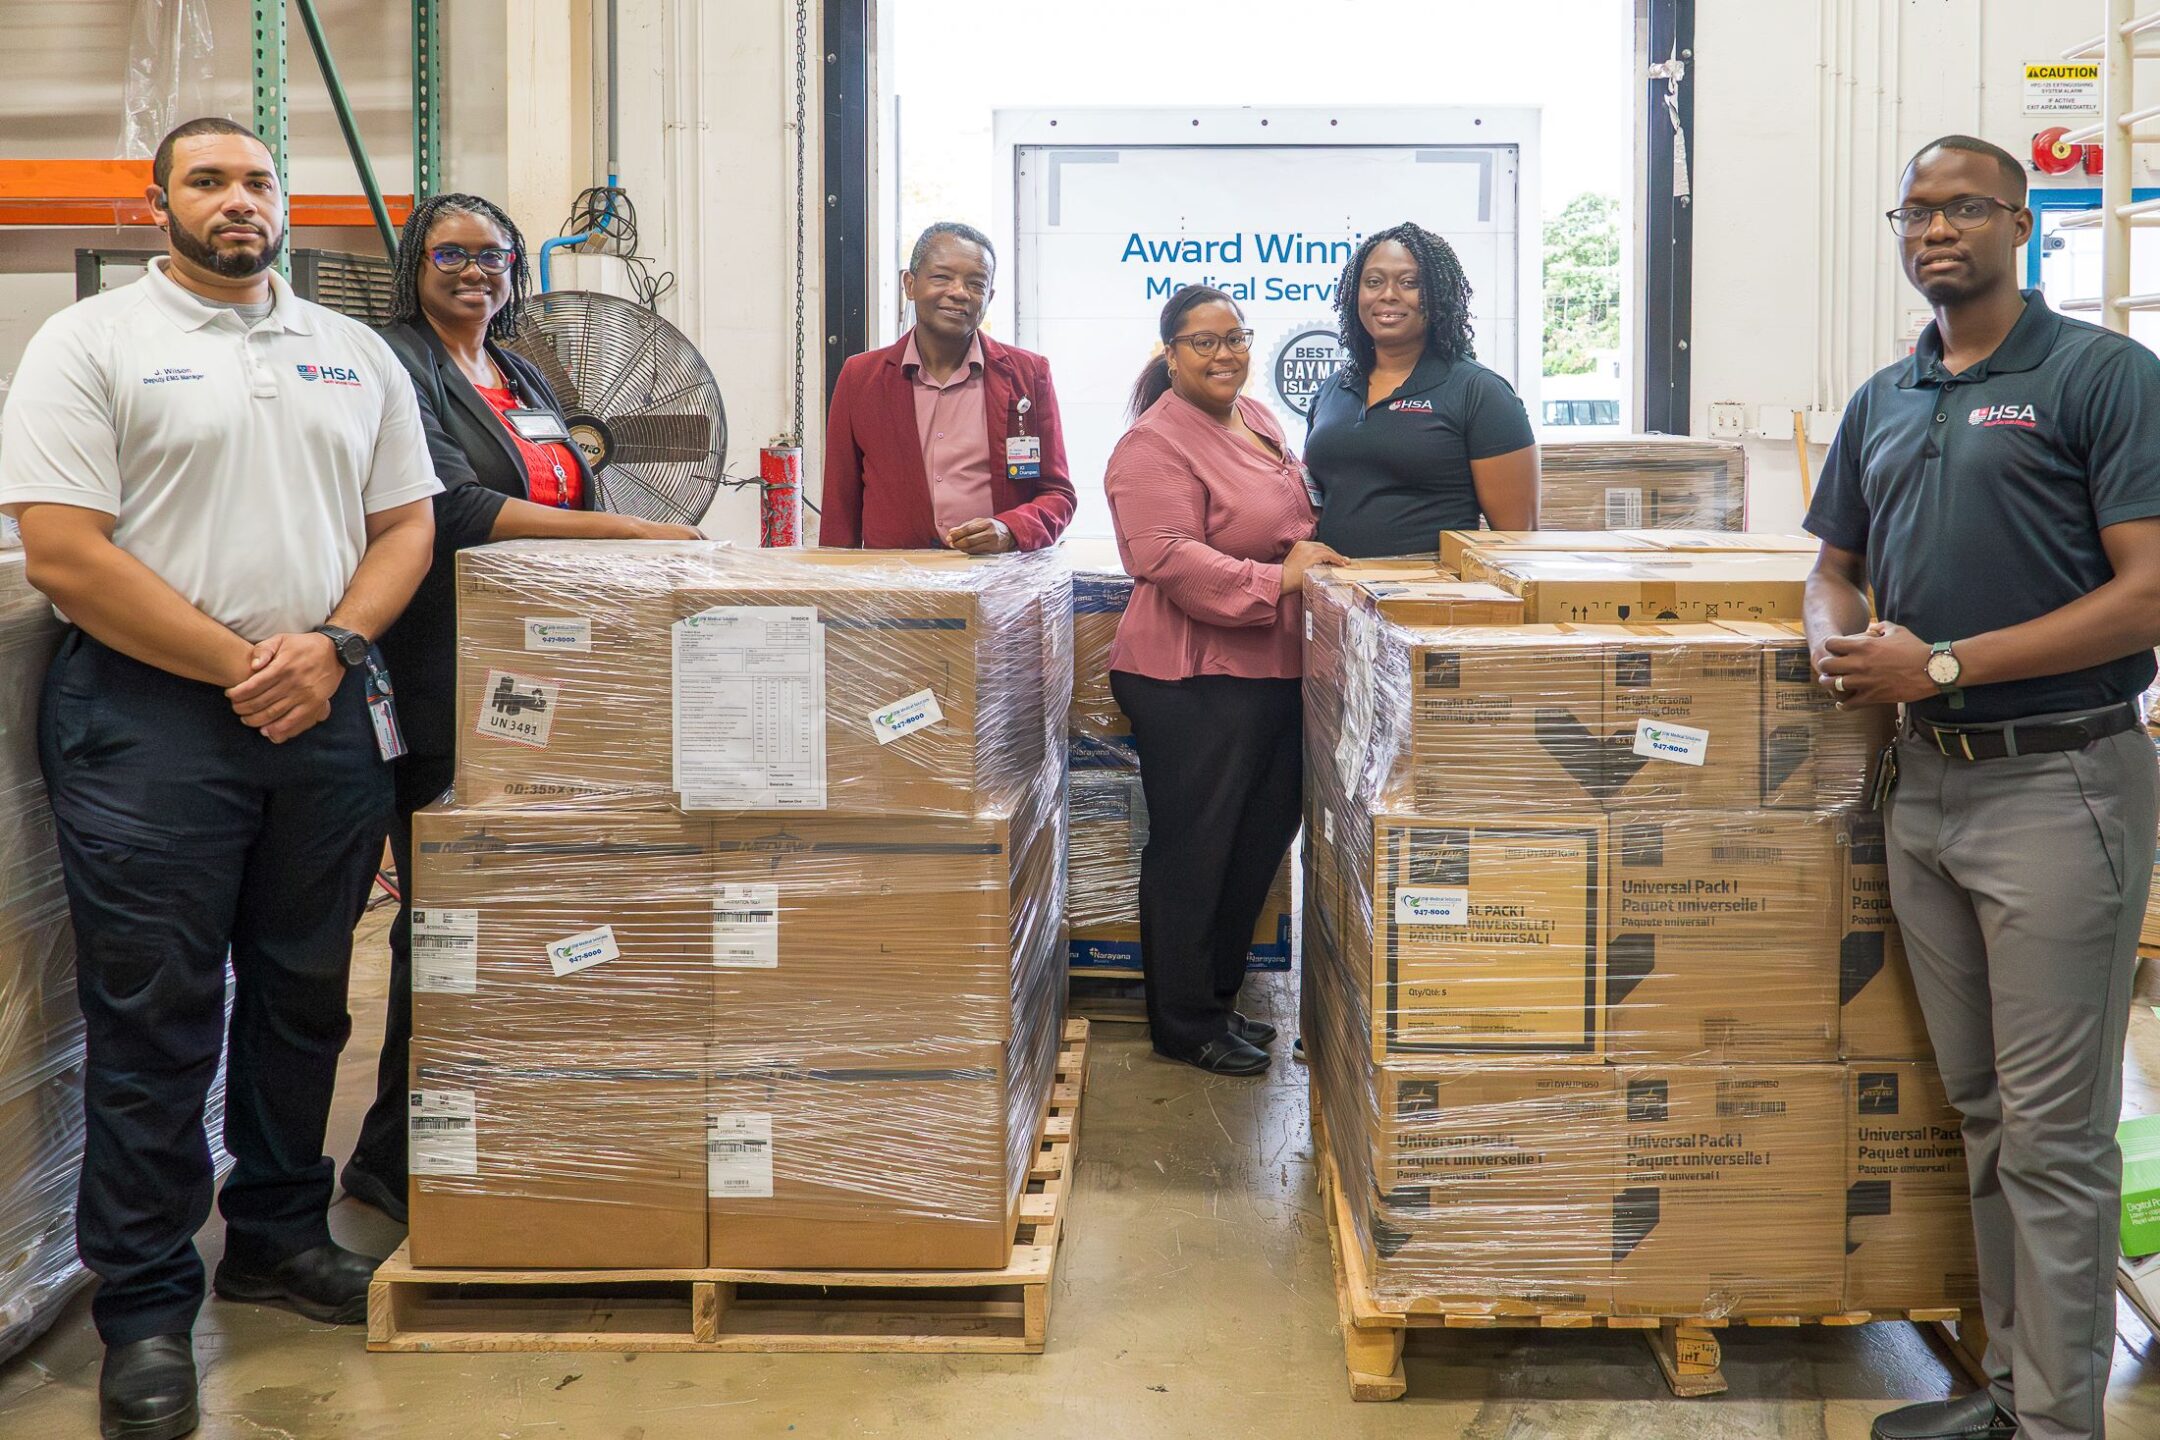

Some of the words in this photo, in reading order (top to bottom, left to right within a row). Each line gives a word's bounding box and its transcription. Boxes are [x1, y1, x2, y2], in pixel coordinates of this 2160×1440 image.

[2039, 67, 2098, 78] CAUTION
[1121, 233, 1242, 263] Award
[1254, 233, 1362, 264] Winni
[1265, 276, 1338, 301] Servi
[1296, 347, 1334, 358] BEST
[320, 366, 360, 381] HSA
[1283, 360, 1343, 380] CAYMA
[143, 376, 165, 384] Deputy
[1283, 381, 1322, 393] ISLA
[1401, 399, 1433, 409] HSA
[1987, 404, 2036, 421] HSA
[1466, 698, 1513, 708] Personal
[1652, 694, 1693, 705] Personal
[1615, 705, 1660, 717] Cleansing
[1661, 706, 1691, 716] Cloths
[490, 716, 508, 728] UN
[510, 720, 537, 736] 3481
[891, 713, 925, 730] 947-8000
[1652, 742, 1688, 754] 947-8000
[1622, 880, 1691, 894] Universal
[1695, 880, 1730, 894] Pack
[1621, 899, 1674, 915] Paquet
[1678, 898, 1758, 912] universelle
[1852, 896, 1890, 913] Paqu
[1485, 906, 1517, 917] PACK
[1621, 917, 1662, 928] Paquete
[1664, 917, 1708, 927] universal
[1409, 932, 1468, 943] PAQUETE
[1470, 933, 1546, 944] UNIVERSAL
[569, 948, 602, 963] 947-8000
[1094, 951, 1131, 960] Narayana
[1408, 988, 1440, 998] Qty/Qté:
[1397, 1133, 1468, 1147] Universal
[1471, 1133, 1506, 1147] Pack
[1858, 1126, 1926, 1141] Universal
[1627, 1133, 1696, 1148] Universal
[1699, 1133, 1736, 1148] Pack
[1397, 1152, 1450, 1168] Paquet
[1453, 1151, 1534, 1166] universelle
[1858, 1146, 1910, 1162] Paquet
[1913, 1144, 1966, 1158] univers
[1627, 1153, 1679, 1169] Paquet
[1682, 1151, 1763, 1166] universelle
[1397, 1170, 1437, 1181] Paquete
[1627, 1171, 1667, 1182] Paquete
[1669, 1170, 1714, 1181] universal
[1858, 1164, 1899, 1176] Paquete
[1901, 1164, 1946, 1174] universal
[2126, 1199, 2152, 1212] Digital
